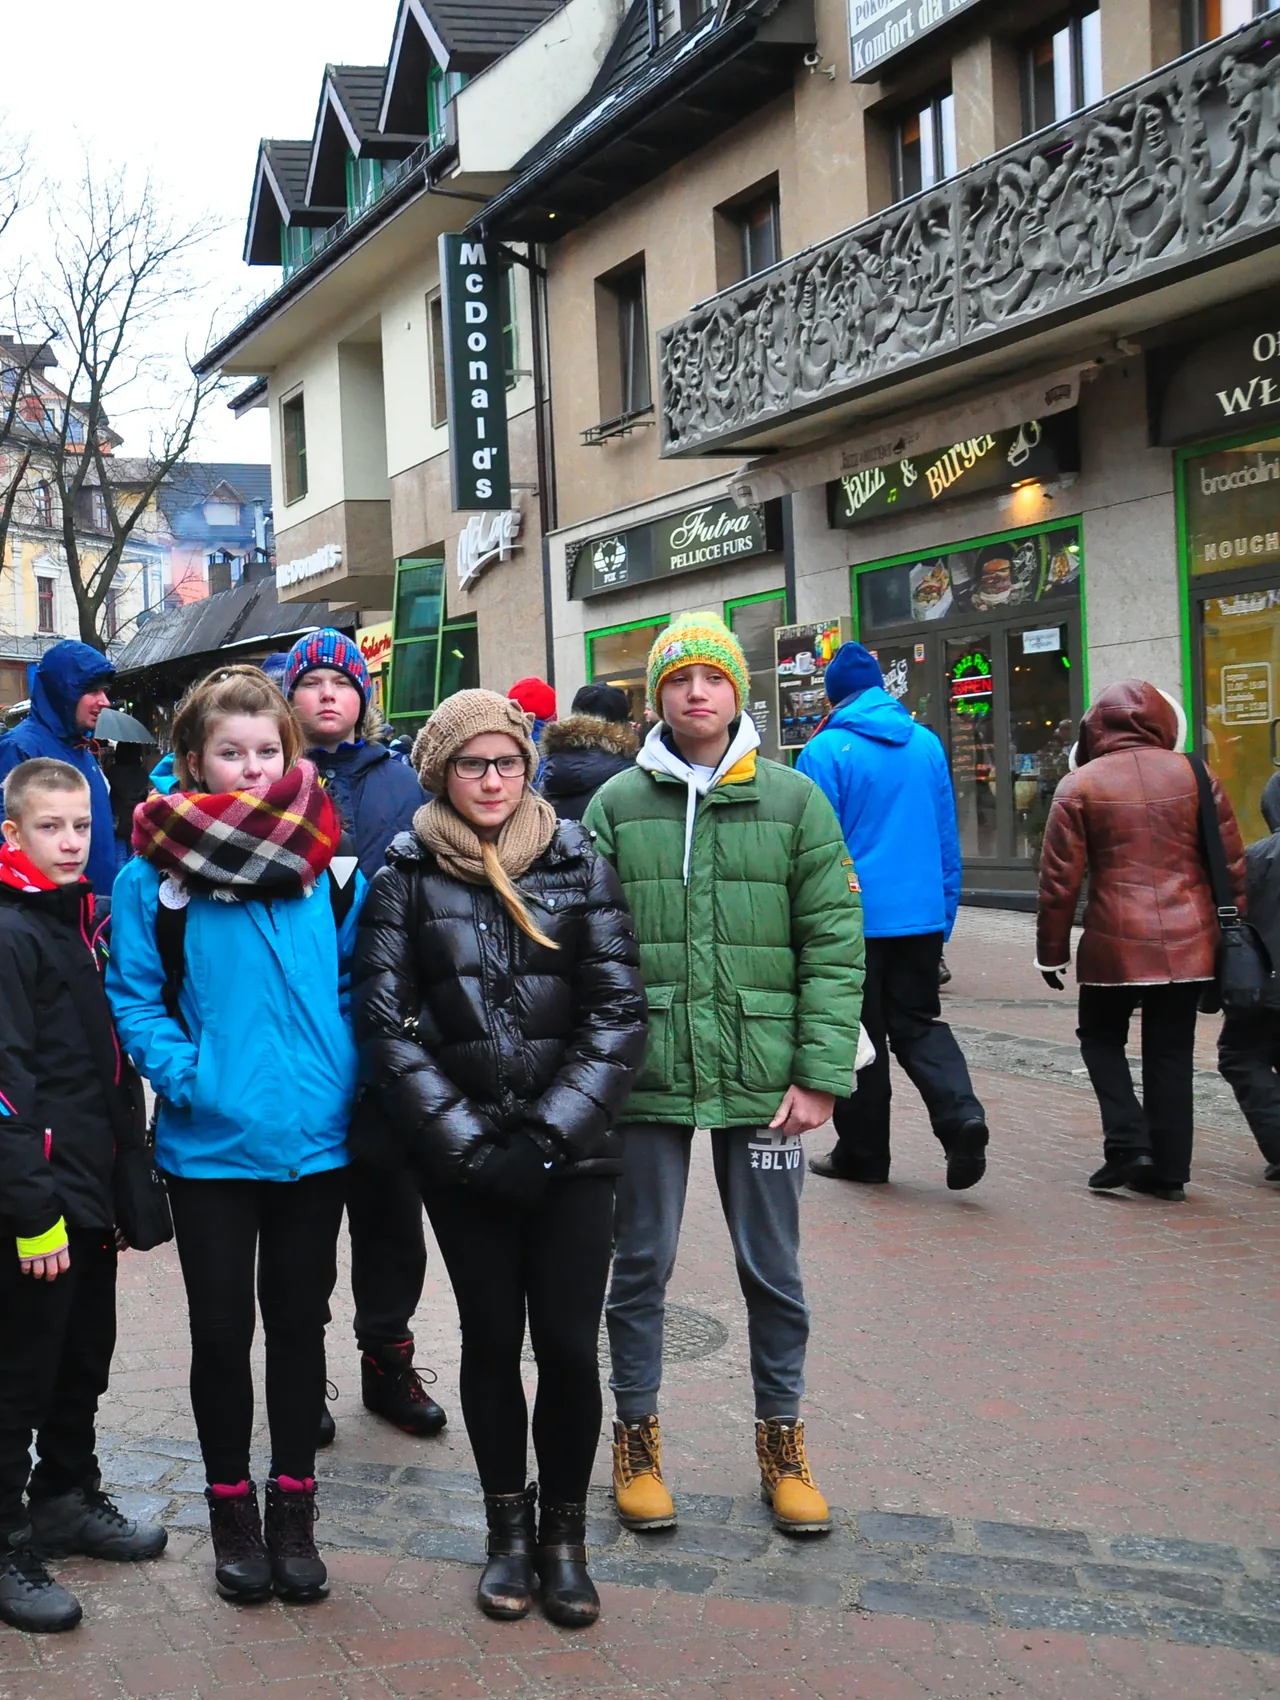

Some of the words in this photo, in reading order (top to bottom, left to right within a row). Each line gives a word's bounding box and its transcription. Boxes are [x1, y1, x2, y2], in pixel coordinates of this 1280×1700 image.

[855, 0, 895, 26] POKO
[853, 8, 915, 74] Komfort
[1252, 331, 1280, 362] O
[459, 242, 498, 499] McDonald's
[900, 458, 918, 488] &
[670, 505, 751, 550] Futra
[670, 546, 722, 570] PELLICCE
[723, 535, 753, 556] FURS
[952, 679, 993, 695] OPEN
[761, 1150, 800, 1170] BLVD
